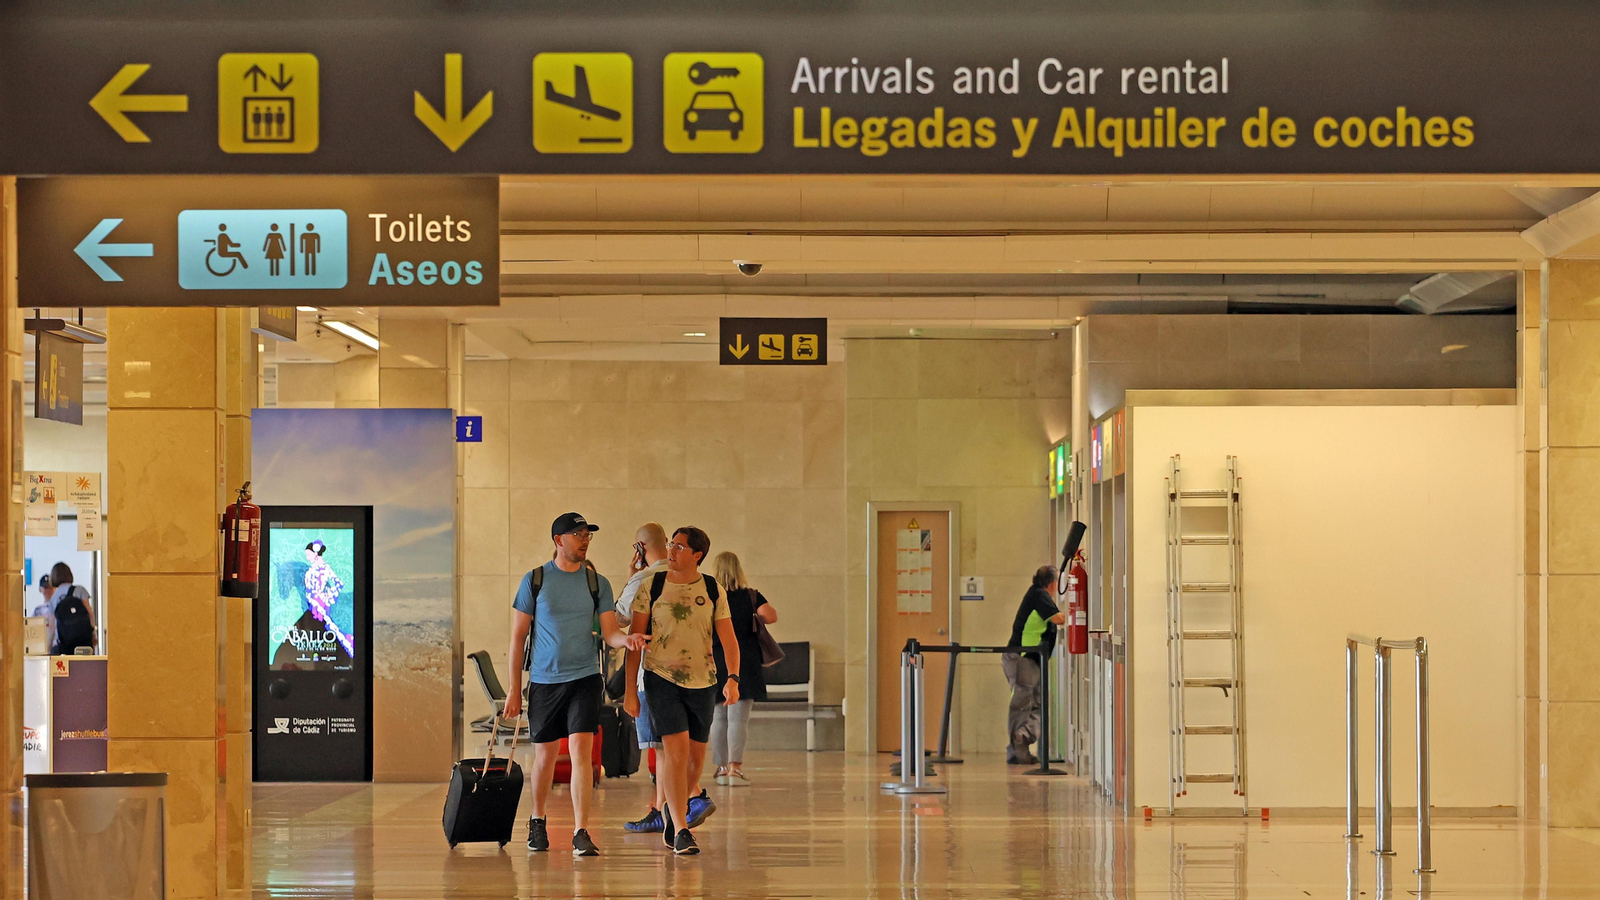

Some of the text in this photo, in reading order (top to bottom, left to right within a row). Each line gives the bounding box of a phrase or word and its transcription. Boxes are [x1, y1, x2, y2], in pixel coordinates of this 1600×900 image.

[791, 57, 1230, 96] Arrivals and Car rental
[792, 106, 1475, 159] Llegadas y Alquiler de coches
[368, 213, 472, 243] Toilets
[368, 252, 484, 286] Aseos
[271, 630, 336, 646] CABALLO
[292, 717, 326, 725] Diputación
[292, 726, 320, 734] de Cádiz
